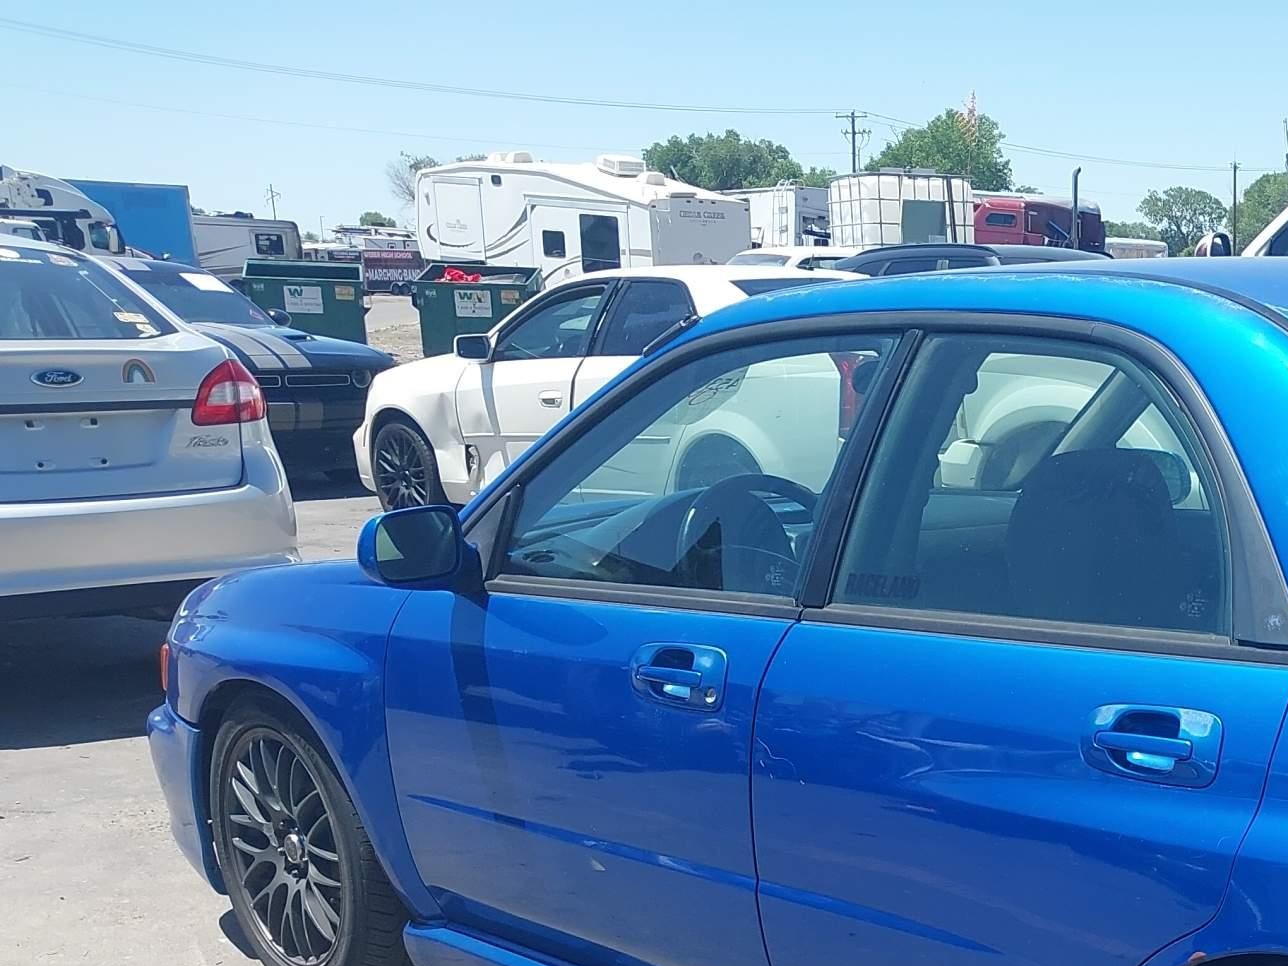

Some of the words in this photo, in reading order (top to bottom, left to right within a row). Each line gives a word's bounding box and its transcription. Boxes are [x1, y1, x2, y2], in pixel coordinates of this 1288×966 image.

[394, 251, 413, 259] SCHOOL
[368, 268, 403, 280] MARCHING
[403, 269, 421, 280] BAND
[45, 371, 73, 383] Ford
